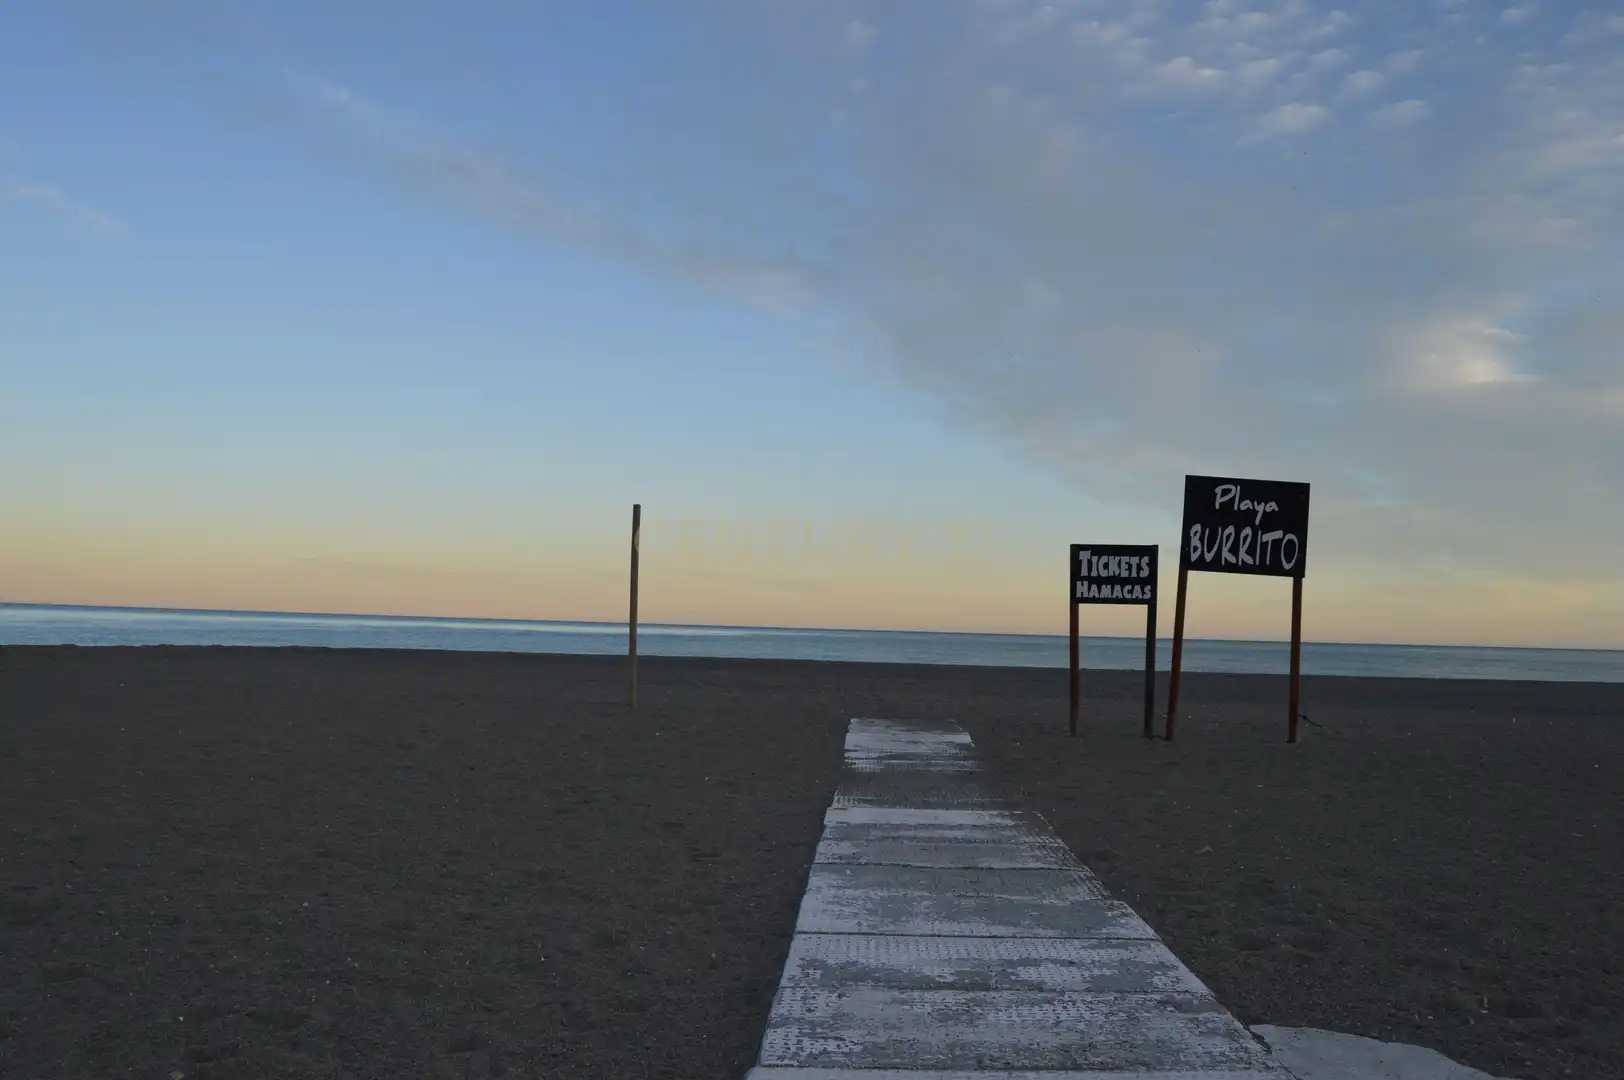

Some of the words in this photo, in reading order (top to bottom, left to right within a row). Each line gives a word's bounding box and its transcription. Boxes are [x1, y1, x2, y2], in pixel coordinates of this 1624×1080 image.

[1214, 484, 1279, 525] Playa
[1079, 550, 1150, 578] TICKETS
[1189, 523, 1299, 571] BURRITO
[1076, 581, 1152, 600] HAMACAS
